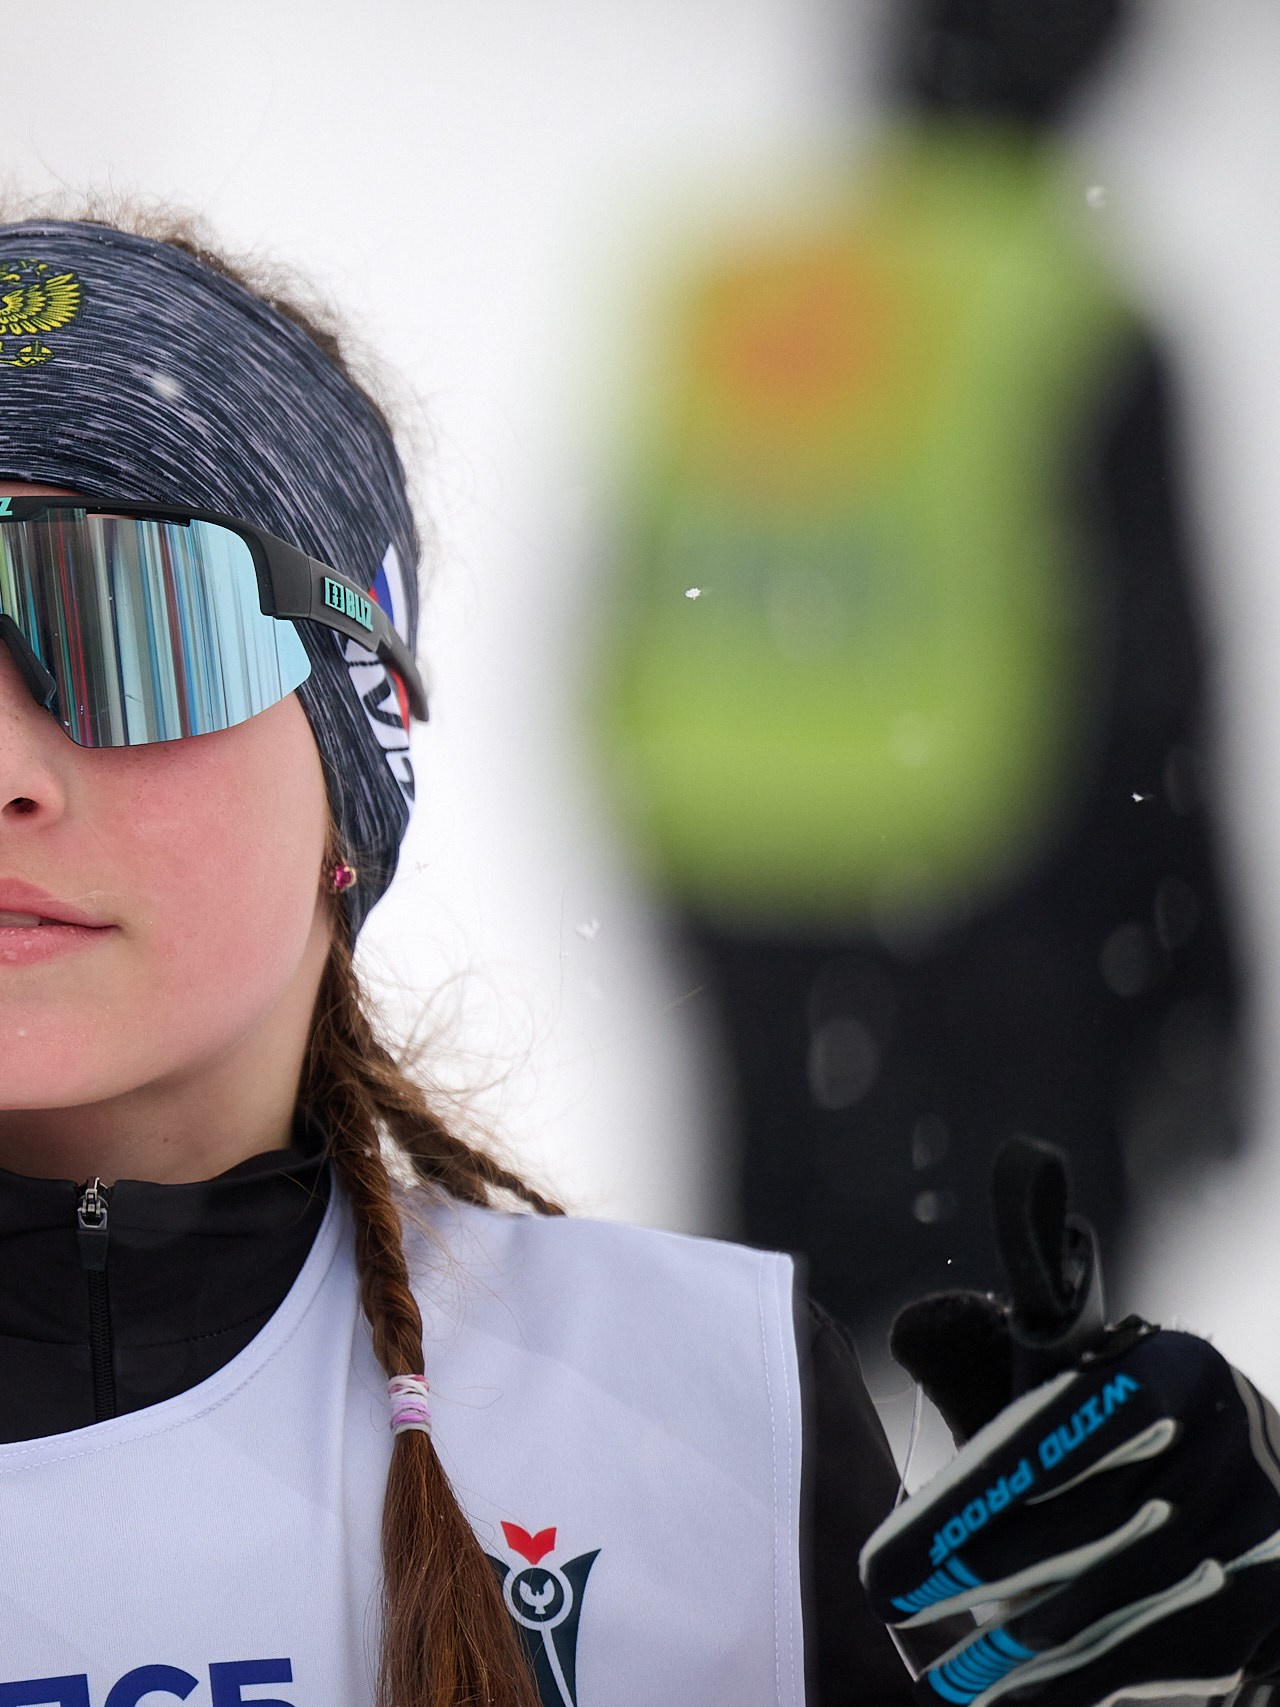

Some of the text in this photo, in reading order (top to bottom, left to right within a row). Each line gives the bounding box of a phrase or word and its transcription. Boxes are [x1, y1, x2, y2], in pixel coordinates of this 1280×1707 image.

[345, 587, 374, 632] BLIZ
[928, 1373, 1141, 1567] WIND PROOF
